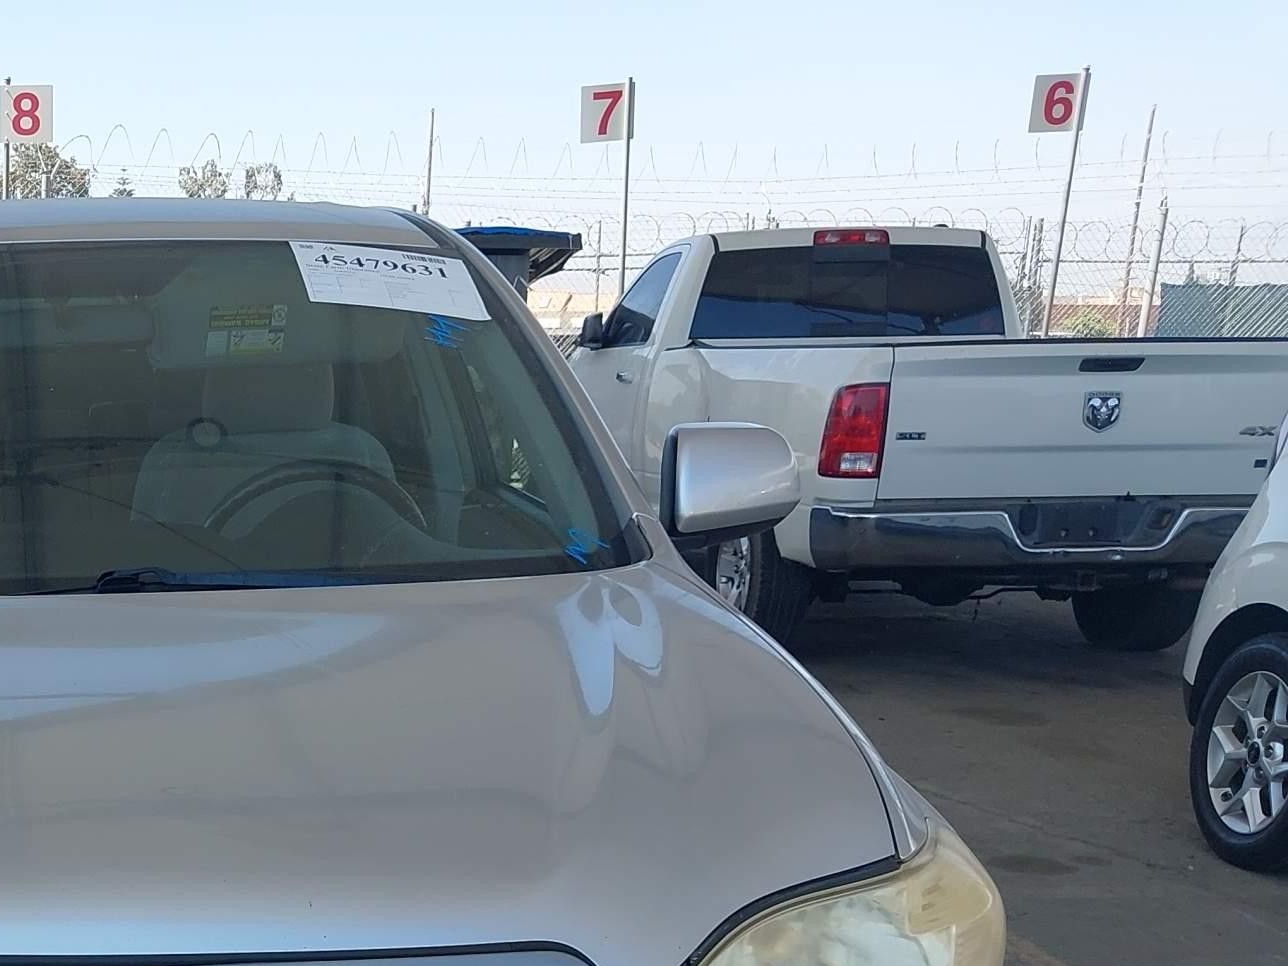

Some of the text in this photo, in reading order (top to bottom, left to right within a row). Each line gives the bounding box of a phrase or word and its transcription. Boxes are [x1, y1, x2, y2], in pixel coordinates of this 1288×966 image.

[12, 92, 41, 136] 8
[592, 89, 623, 136] 7
[1044, 80, 1075, 126] 6
[314, 253, 449, 279] 45479631
